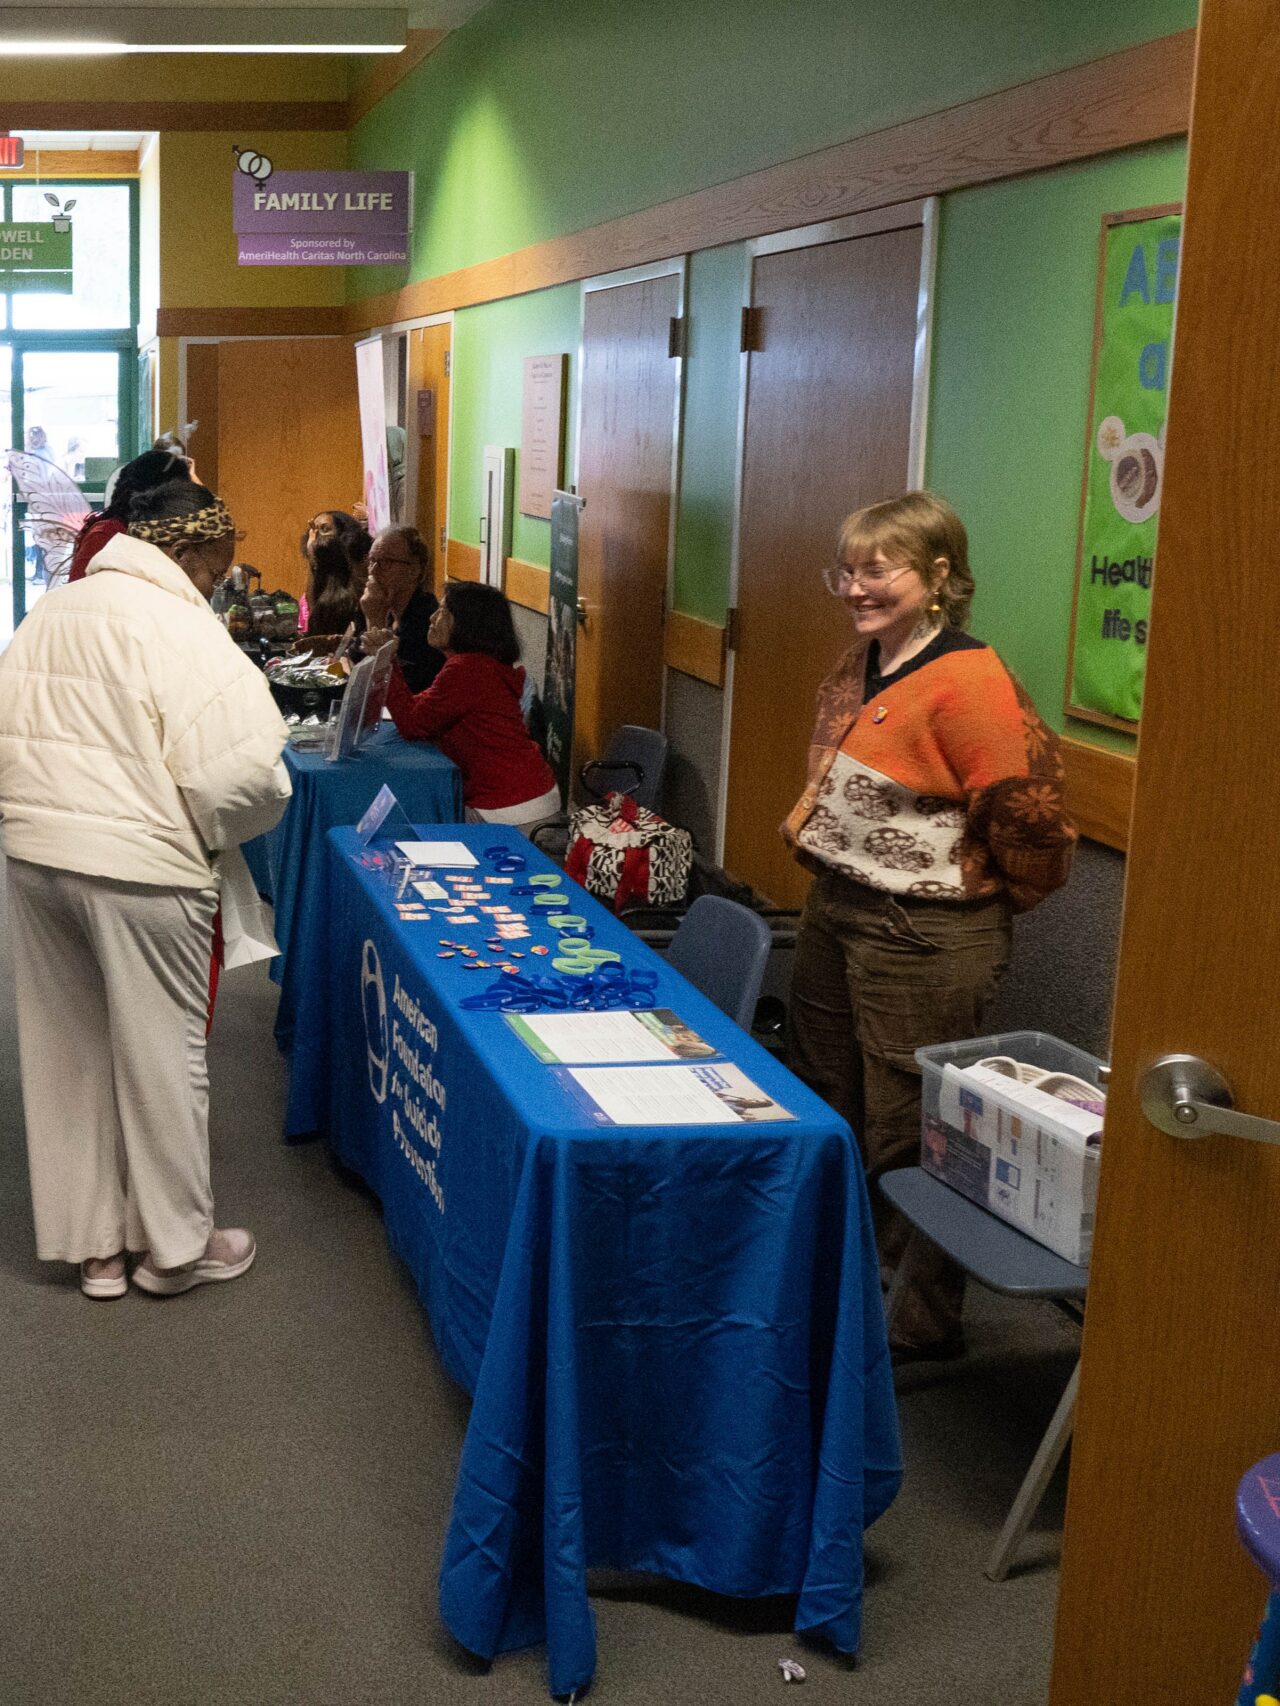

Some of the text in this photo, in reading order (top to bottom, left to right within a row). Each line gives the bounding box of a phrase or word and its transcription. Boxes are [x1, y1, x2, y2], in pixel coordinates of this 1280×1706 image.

[253, 193, 393, 211] FAMILY LIFE
[290, 238, 356, 248] Sponsored by
[238, 251, 407, 261] AmeriHealth Caritas North Carolina
[1091, 555, 1153, 589] Healt
[392, 973, 438, 1053] American
